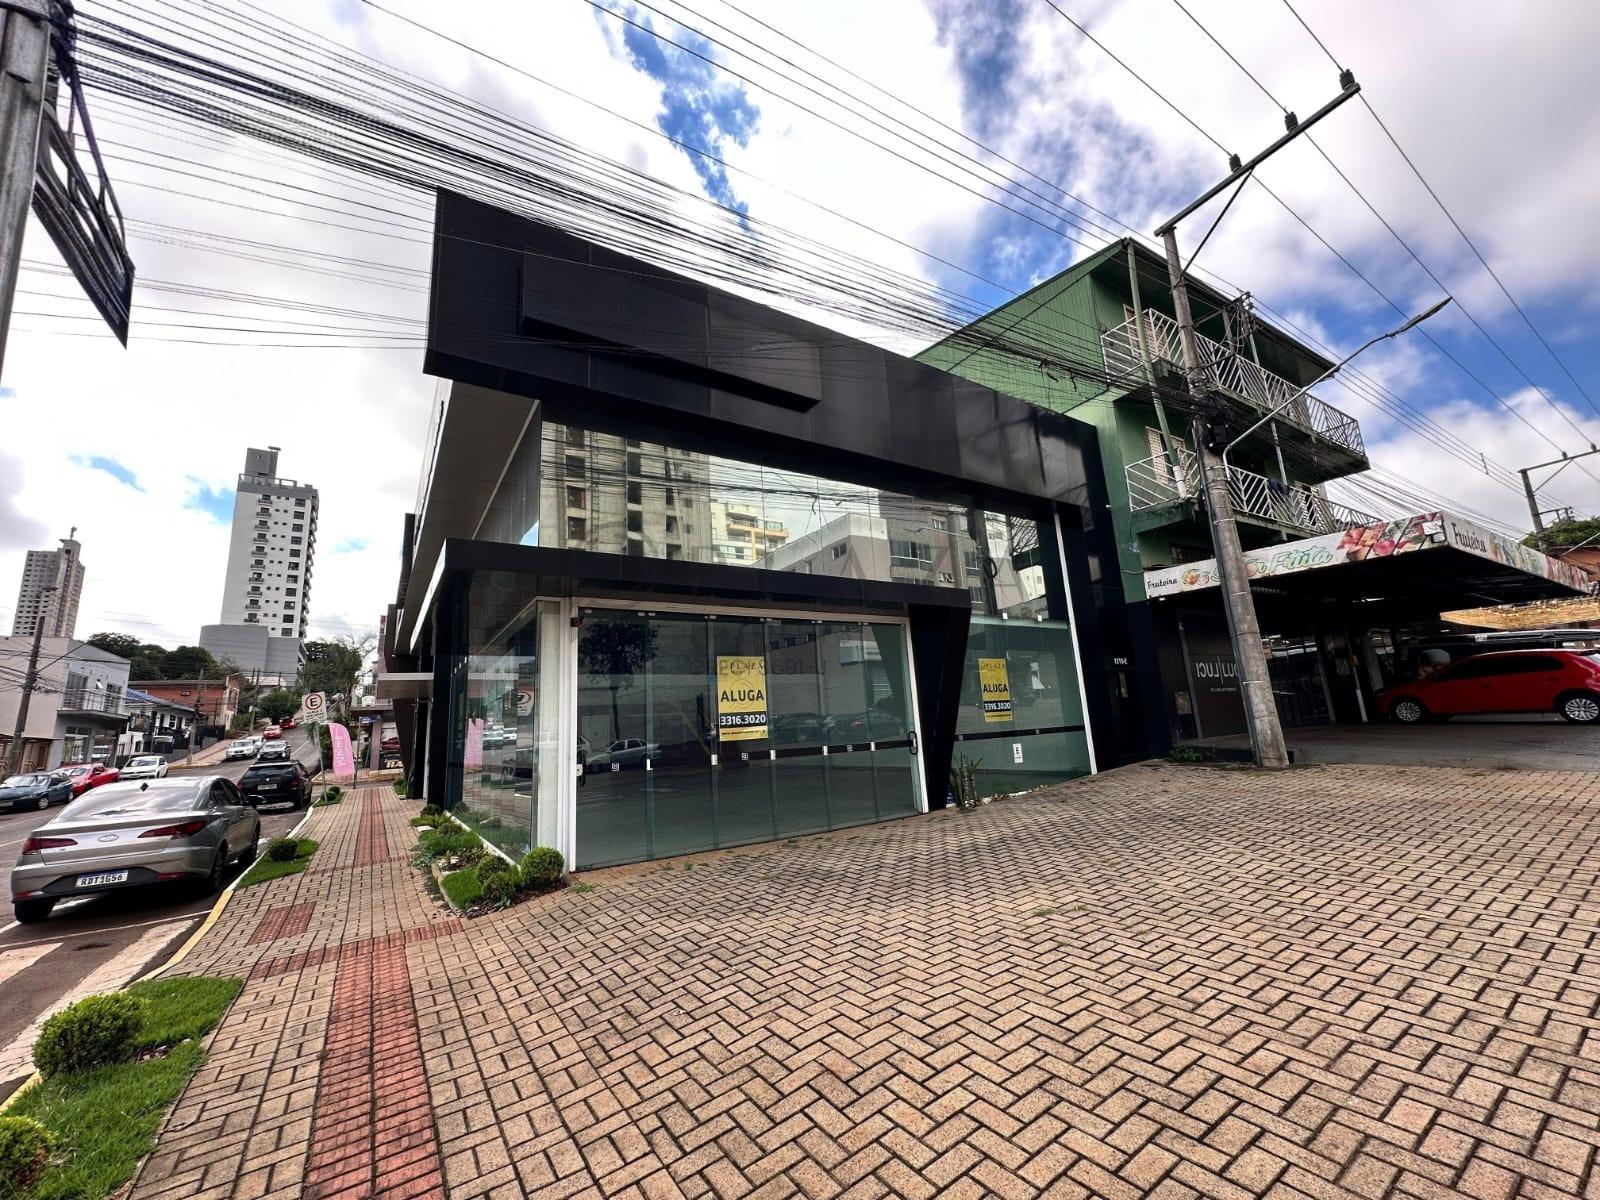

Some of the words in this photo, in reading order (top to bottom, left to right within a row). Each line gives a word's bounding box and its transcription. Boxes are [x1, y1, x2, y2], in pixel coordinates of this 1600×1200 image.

[1450, 521, 1487, 553] Fruteira
[1147, 578, 1178, 589] Fruteira
[983, 683, 1008, 693] ALUGA
[720, 689, 765, 702] ALUGA
[310, 697, 318, 707] E
[720, 714, 766, 726] 3316.3020
[81, 874, 123, 886] RDT1G56
